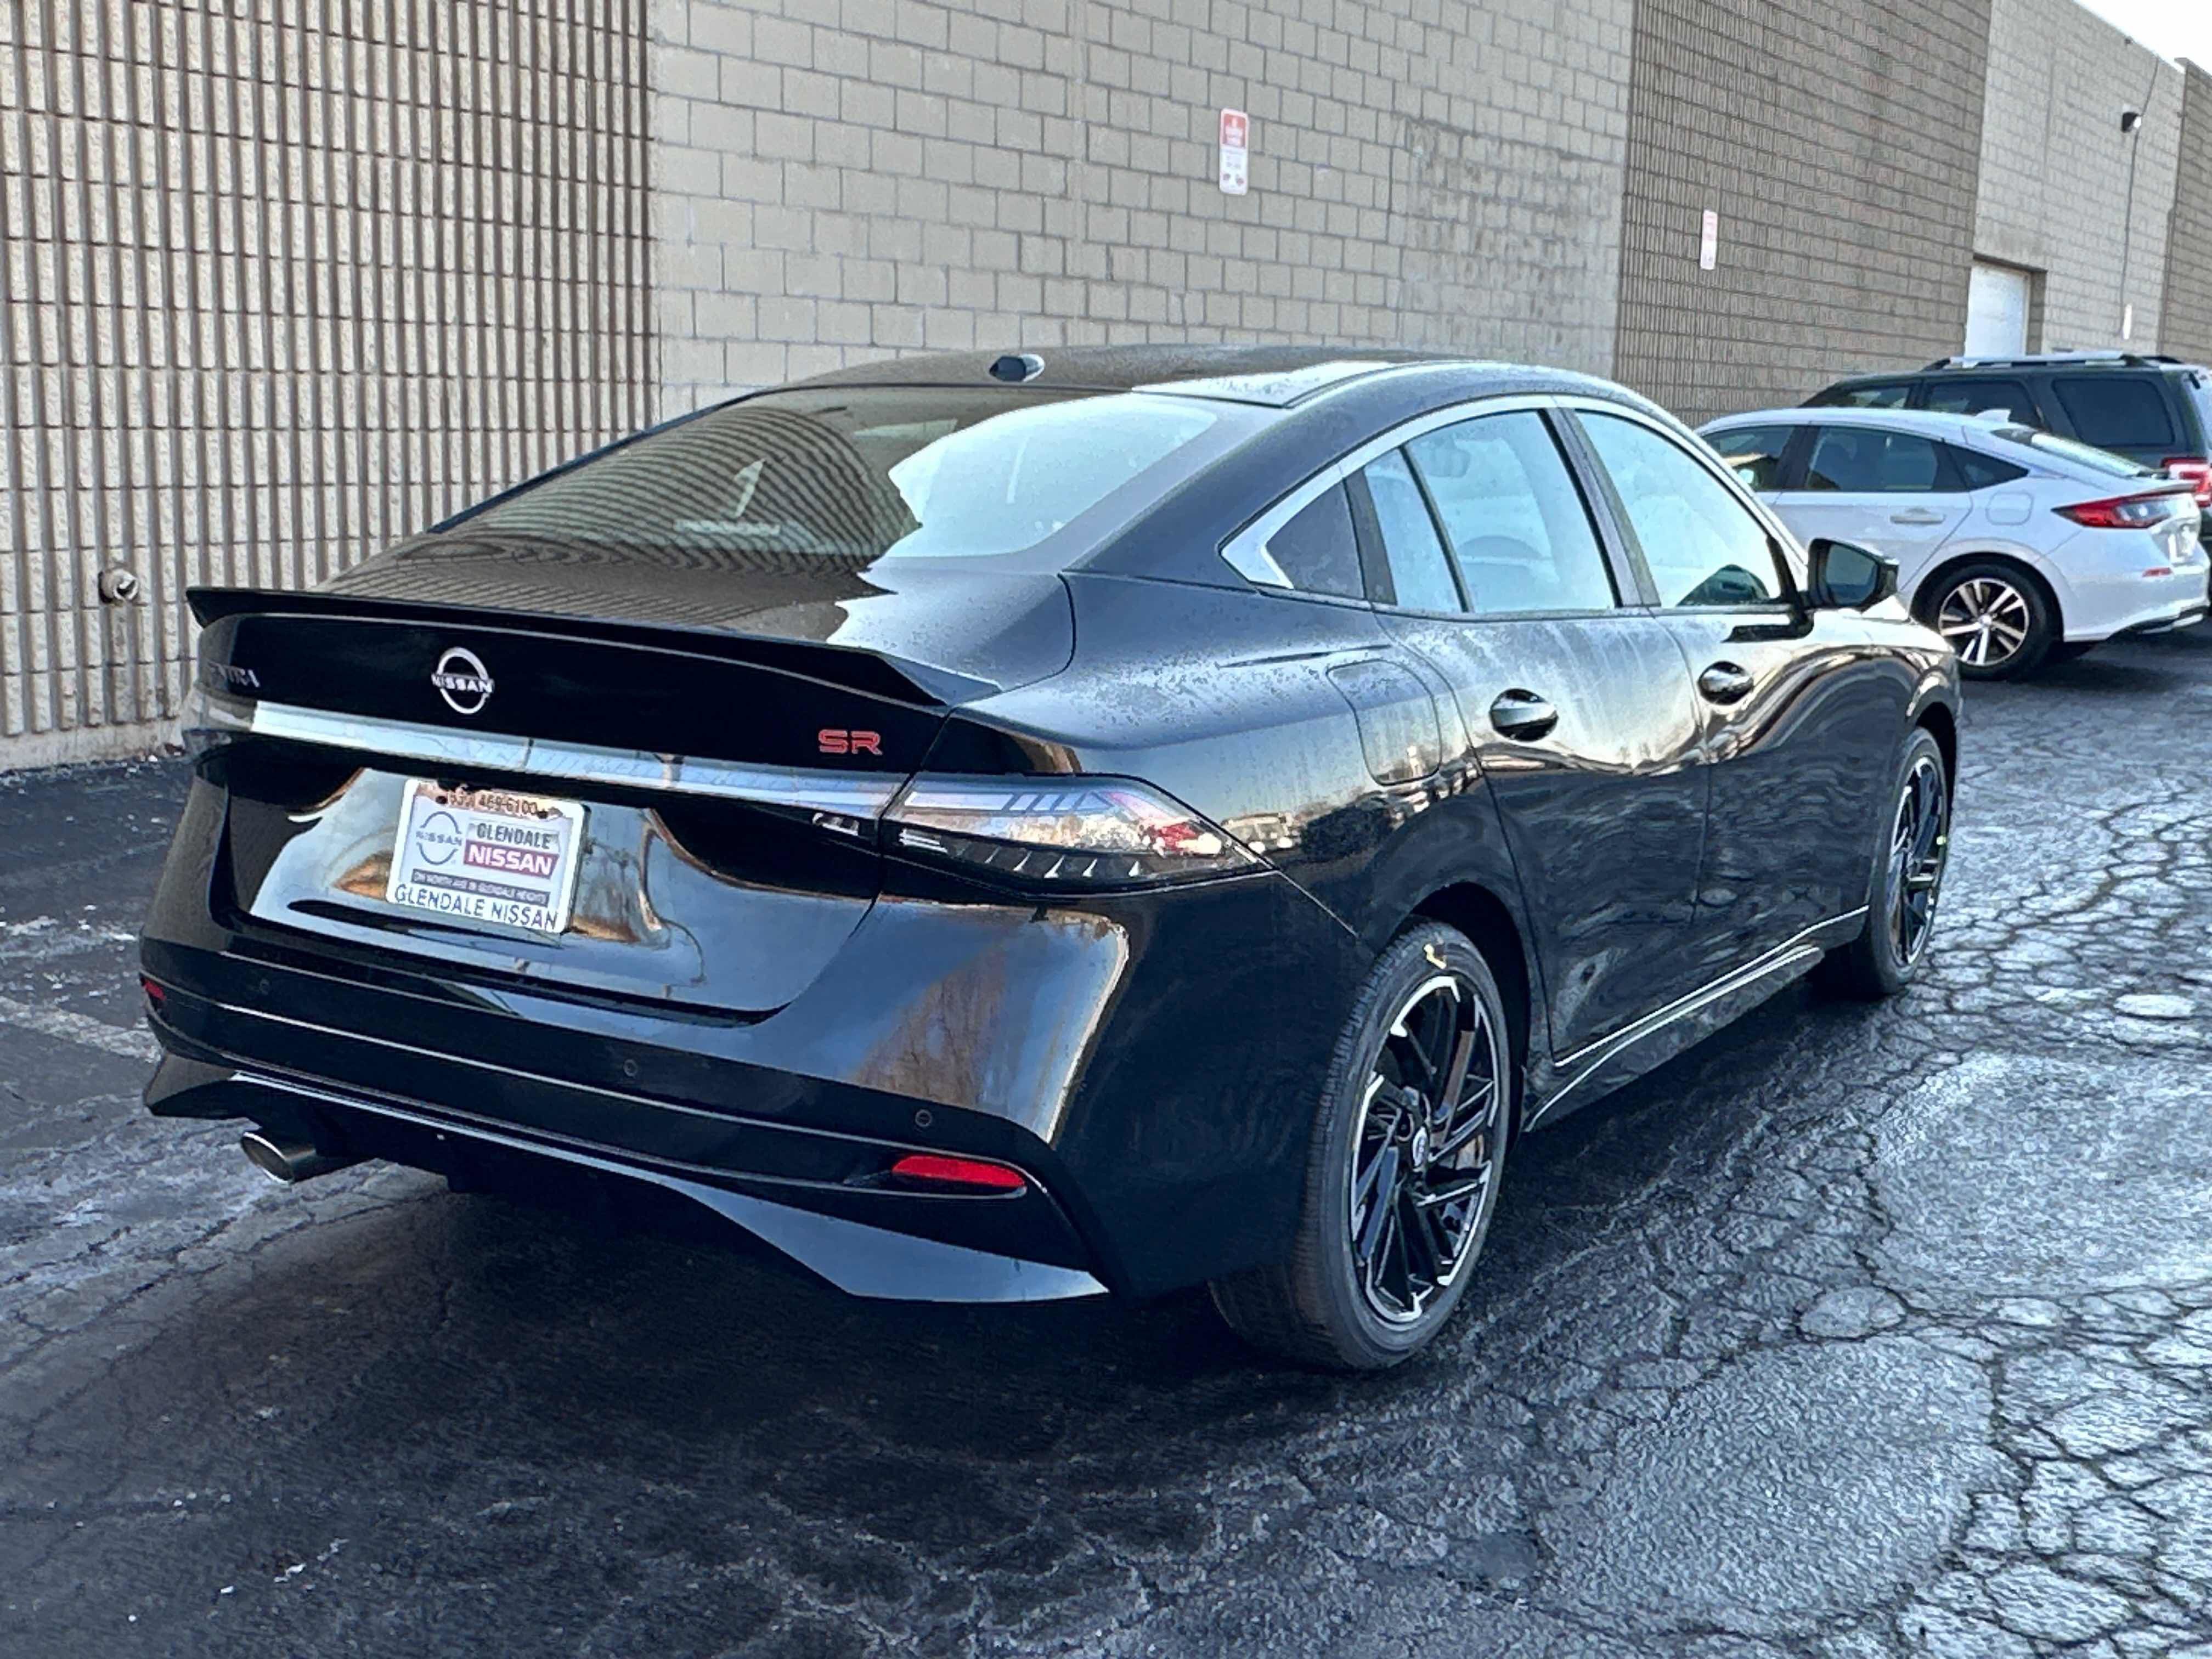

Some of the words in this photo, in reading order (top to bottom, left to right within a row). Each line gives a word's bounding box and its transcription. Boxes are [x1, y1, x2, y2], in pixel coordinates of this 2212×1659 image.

[431, 673, 494, 693] NISSAN
[818, 729, 883, 755] SR
[415, 830, 462, 846] NISSAN
[476, 822, 550, 849] GLENDALE
[467, 844, 553, 876] NISSAN
[394, 883, 486, 916] GLENDALE
[491, 902, 559, 930] NISSAN
